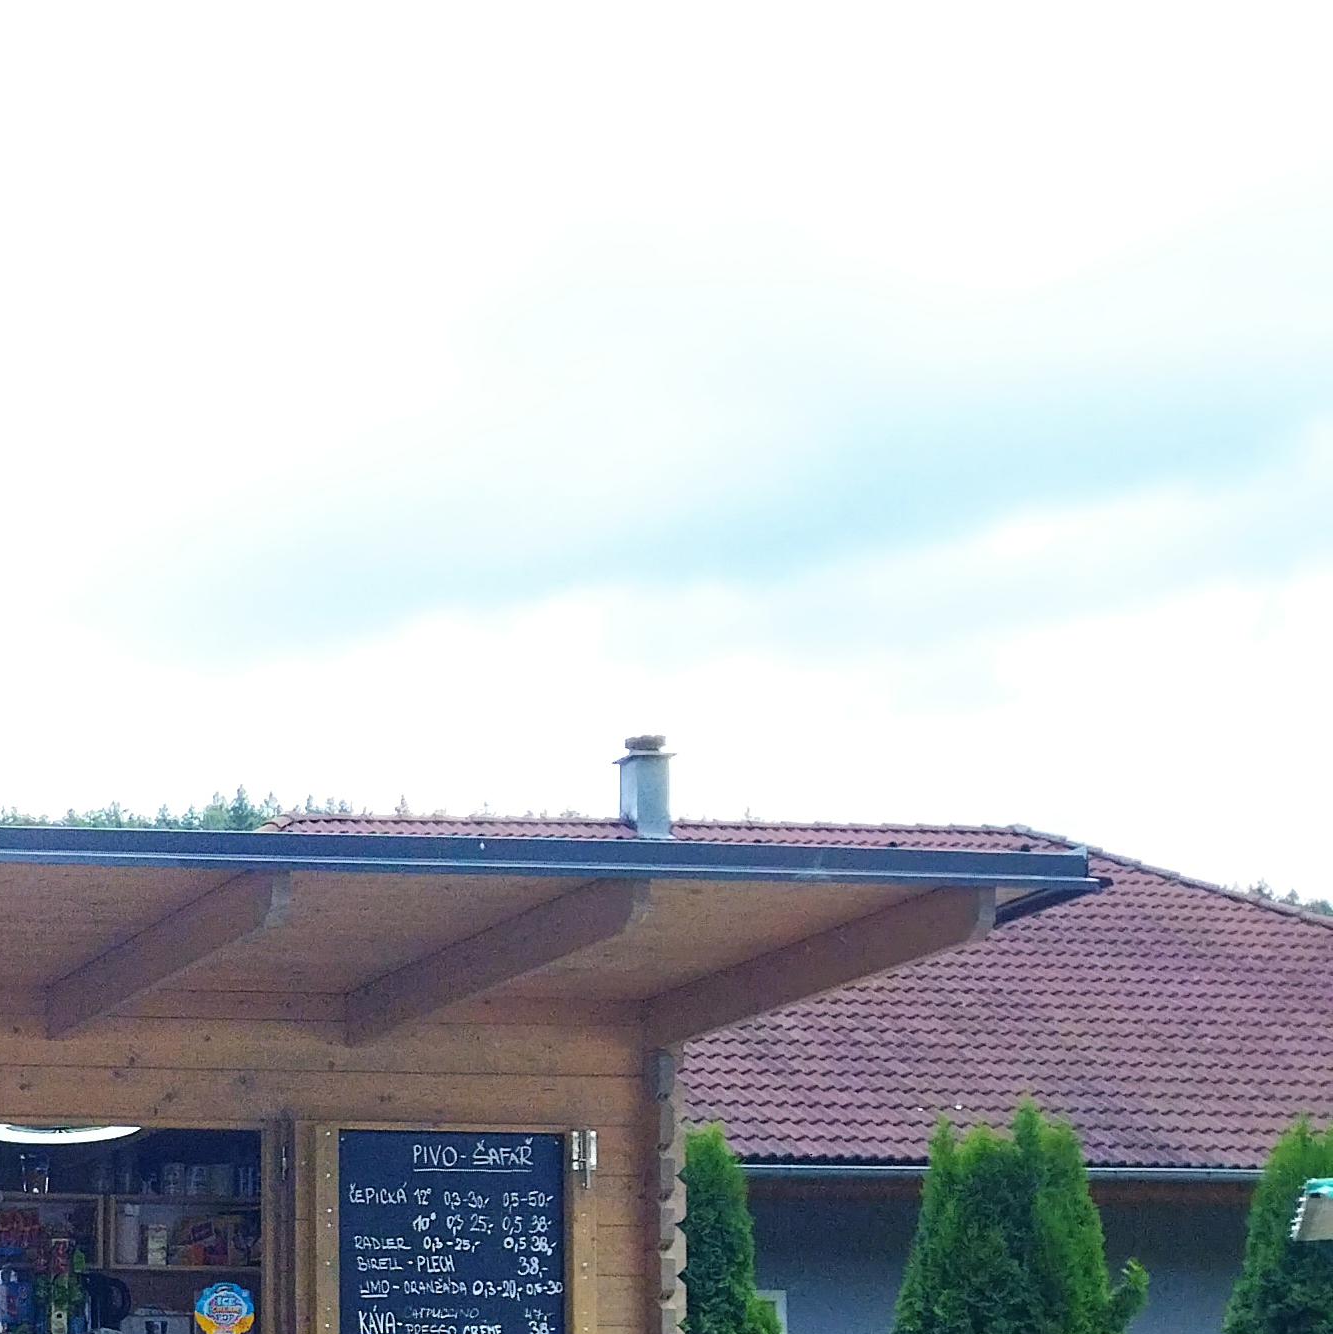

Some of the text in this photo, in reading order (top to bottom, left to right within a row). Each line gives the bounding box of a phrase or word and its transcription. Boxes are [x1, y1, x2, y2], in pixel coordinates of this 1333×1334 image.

[502, 1216, 523, 1235] 0,5
[354, 1236, 412, 1250] RADLER
[503, 1236, 527, 1253] 0,5
[357, 1256, 404, 1271] BIRELL
[416, 1255, 456, 1273] PLECH
